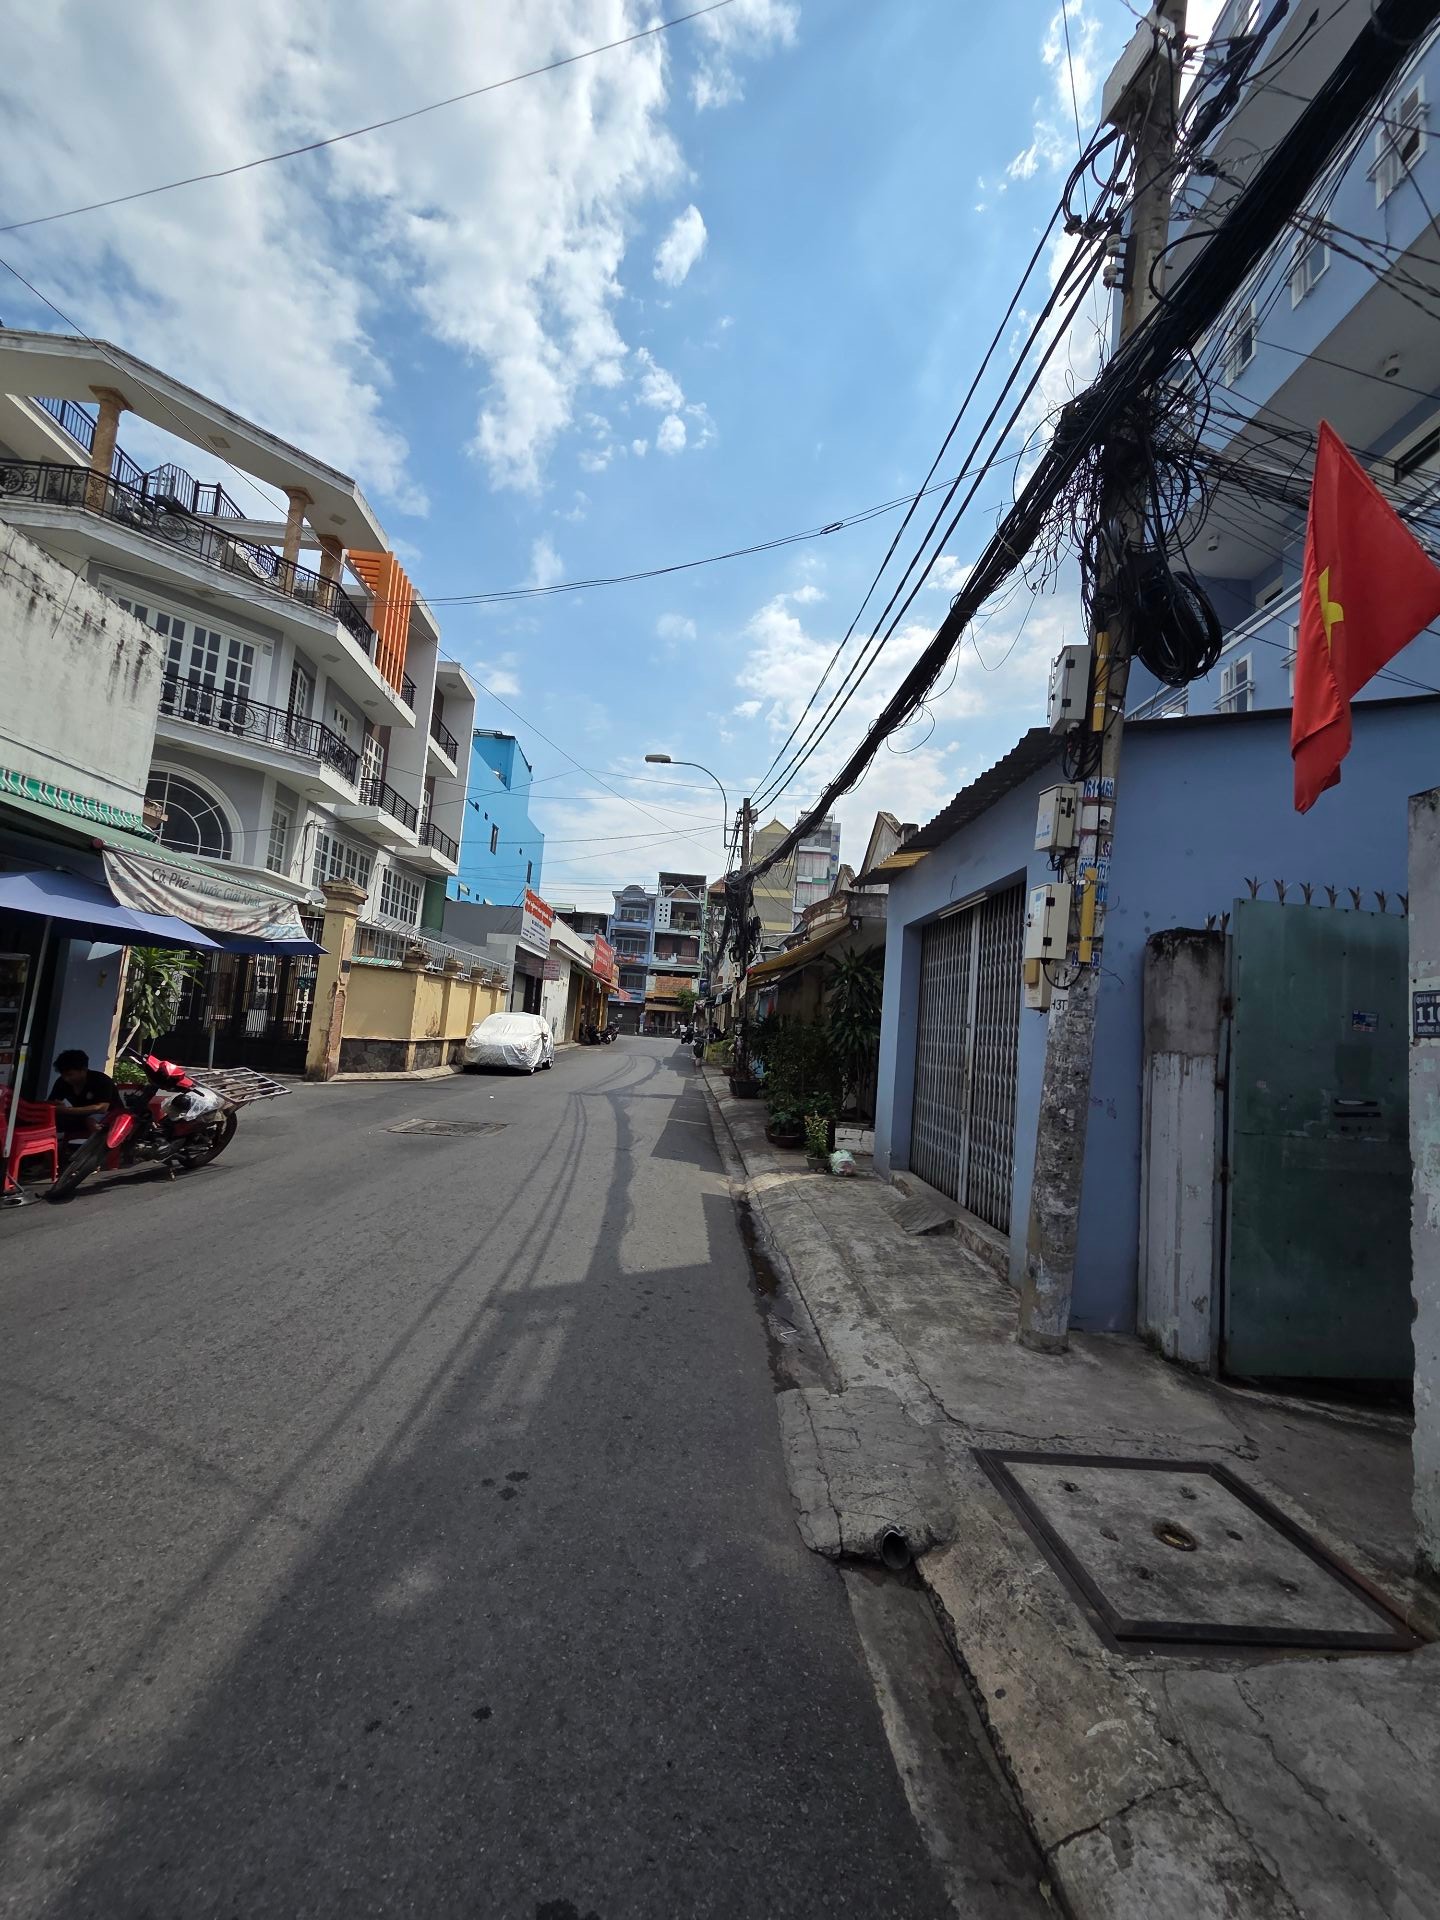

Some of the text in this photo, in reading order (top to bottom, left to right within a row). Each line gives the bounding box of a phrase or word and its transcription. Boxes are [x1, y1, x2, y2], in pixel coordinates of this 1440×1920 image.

[169, 872, 190, 890] Phê
[197, 880, 222, 898] Nước
[223, 887, 242, 903] Giải
[241, 892, 262, 908] Khát
